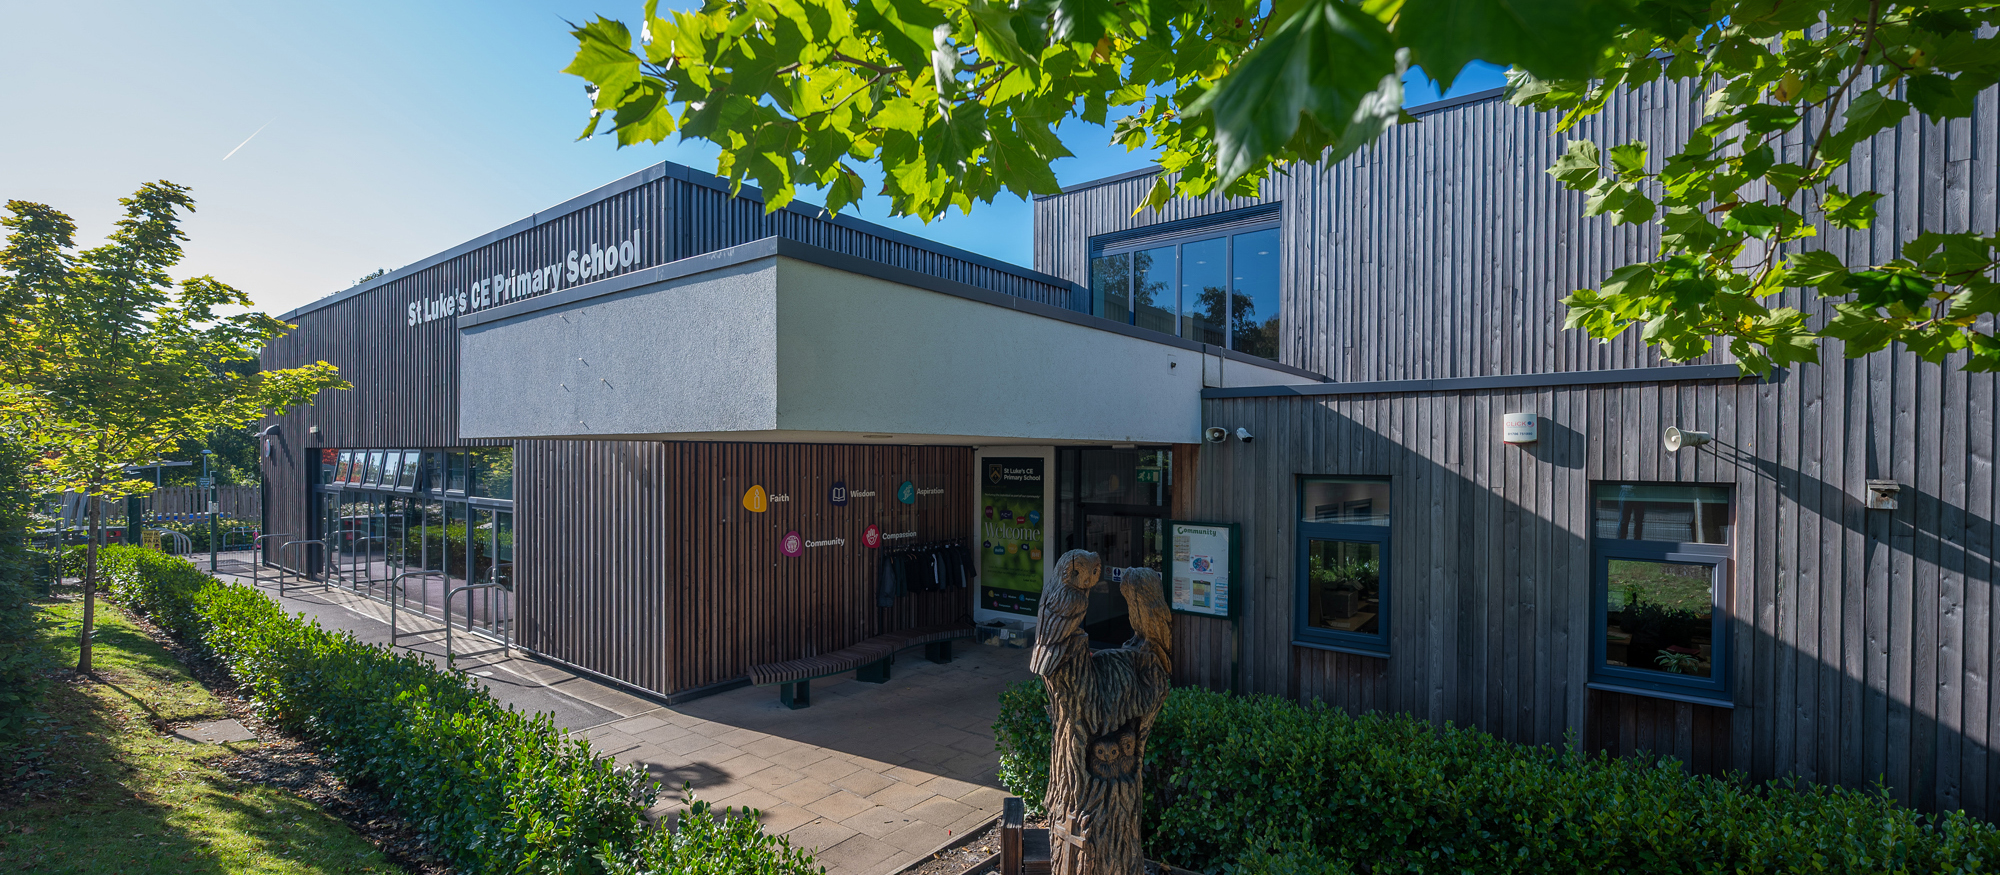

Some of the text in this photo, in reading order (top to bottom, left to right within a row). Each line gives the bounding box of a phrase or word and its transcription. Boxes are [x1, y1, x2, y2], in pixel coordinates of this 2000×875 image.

[408, 229, 641, 327] St Luke's CE Primary School
[850, 489, 876, 498] Wisdom
[916, 487, 944, 496] Aspiration
[769, 492, 790, 503] Faith
[882, 529, 917, 541] Compassion
[984, 522, 1040, 542] Welcome
[1177, 526, 1217, 537] Community
[804, 536, 845, 548] Community
